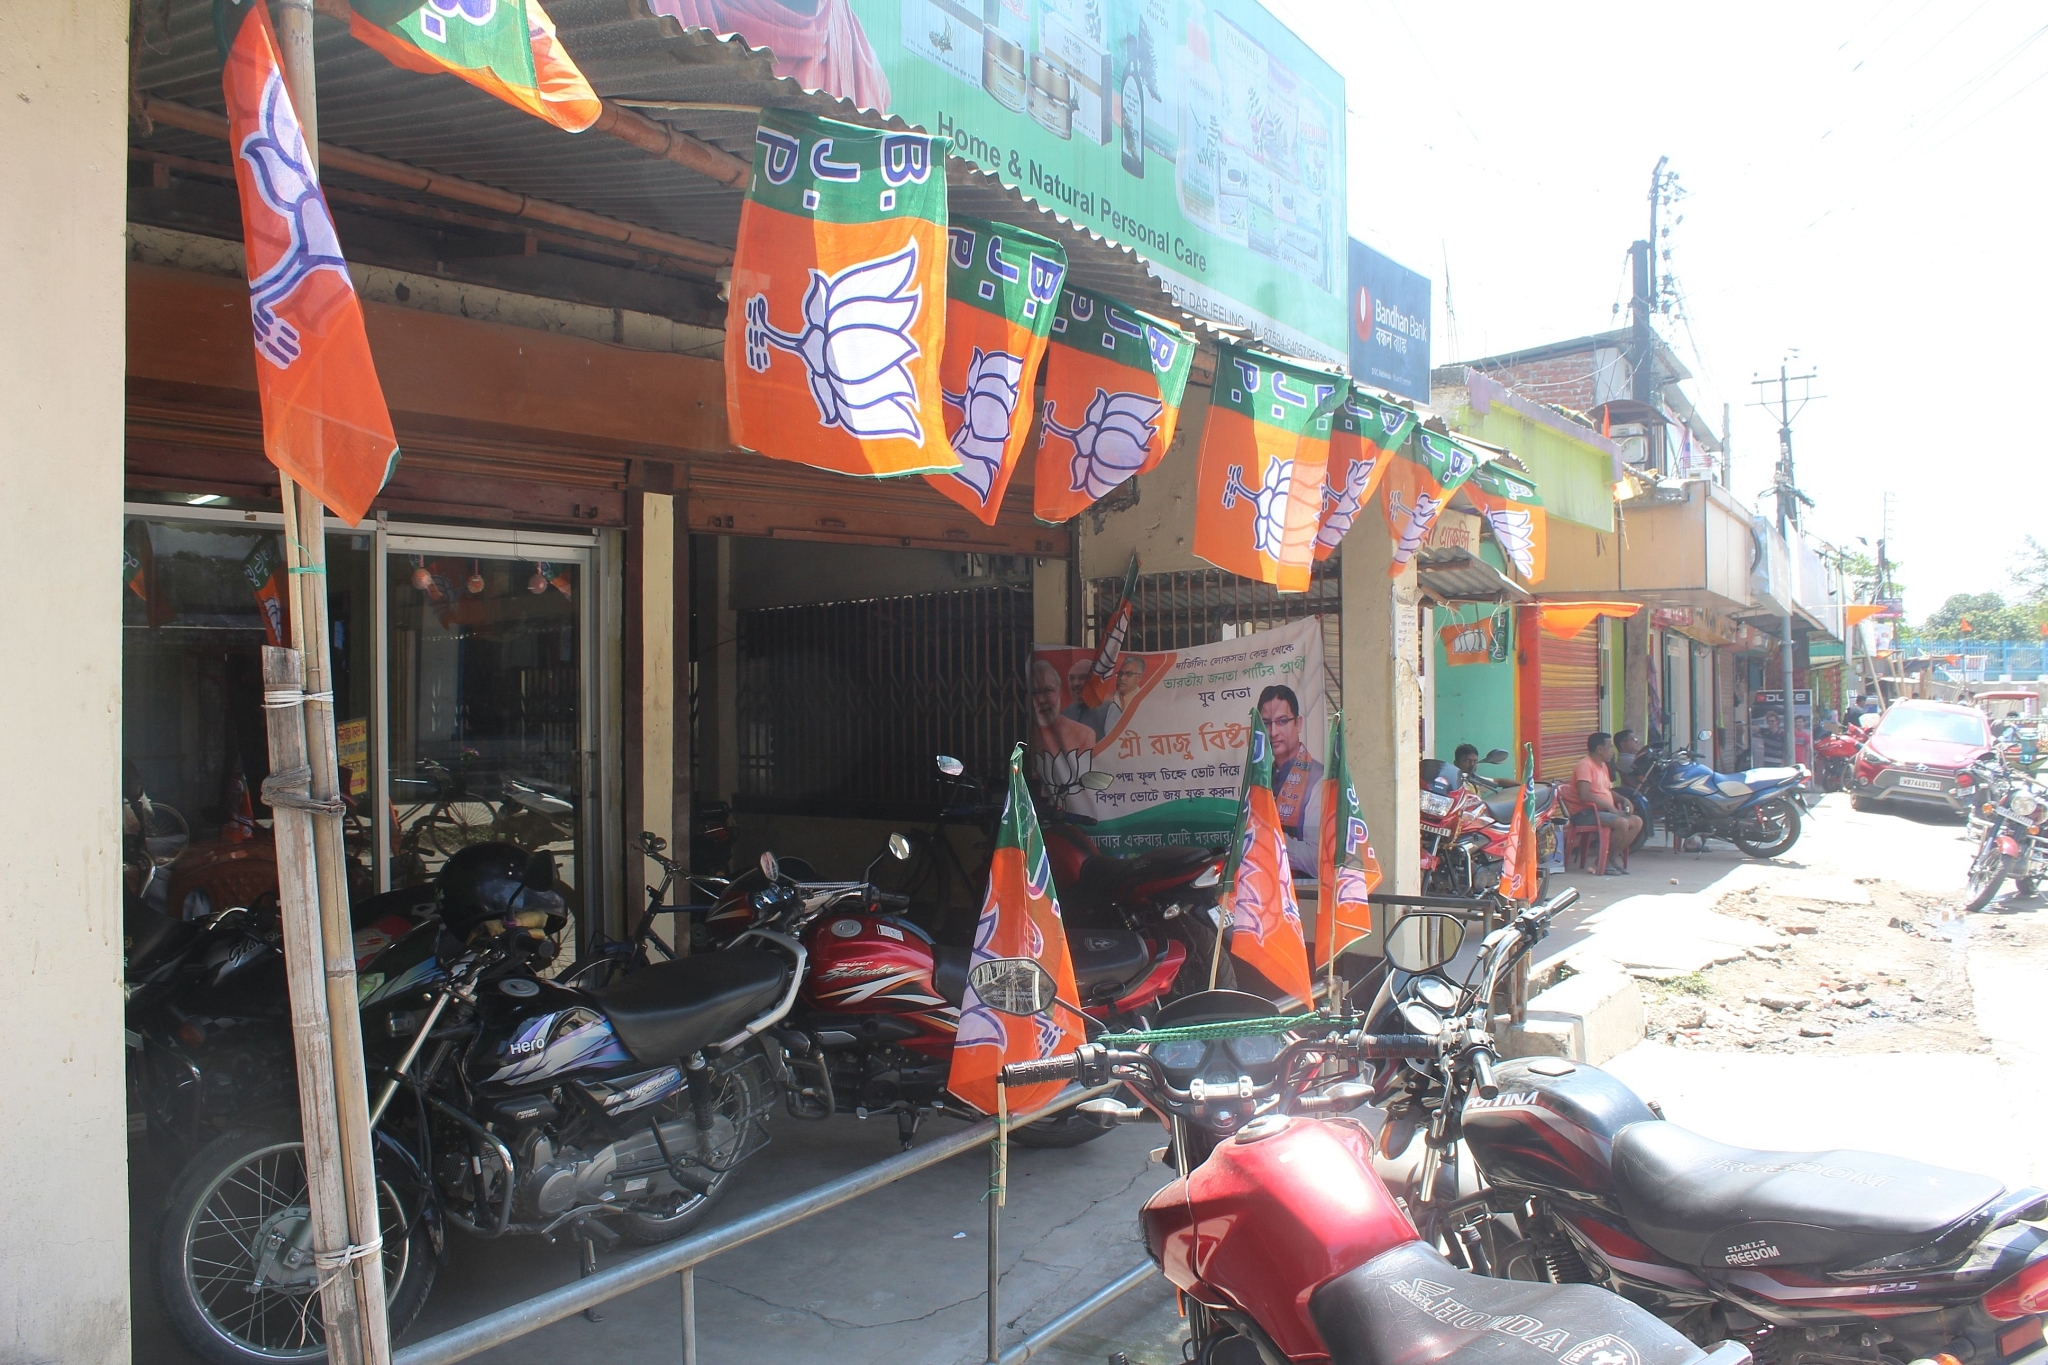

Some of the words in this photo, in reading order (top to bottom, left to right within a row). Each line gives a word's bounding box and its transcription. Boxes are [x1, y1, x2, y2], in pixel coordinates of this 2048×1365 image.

[938, 111, 1001, 168] Home
[1008, 149, 1023, 180] &
[1029, 158, 1095, 217] Natural
[1100, 198, 1170, 255] Personal
[1174, 238, 1207, 273] Care
[1190, 291, 1244, 327] DARJEELING
[1376, 298, 1409, 335] Bandhan
[1410, 315, 1427, 343] Bank
[1210, 652, 1247, 666] লোকসভা
[1271, 643, 1295, 655] থেকে
[1163, 673, 1204, 689] ভারতীয়
[1208, 670, 1238, 684] জনতা
[1242, 662, 1276, 679] পার্টির
[1198, 691, 1216, 708] যুব
[1221, 686, 1252, 701] নেতা
[1118, 729, 1141, 760] শ্রী
[1148, 733, 1195, 761] রাজু
[1116, 771, 1135, 783] পদ্ম
[1137, 771, 1157, 786] ফুল
[1161, 767, 1187, 781] চিহ্নে
[1192, 765, 1216, 779] ভোট
[1219, 762, 1241, 777] দিয়ে
[1095, 790, 1126, 807] বিপুল
[1130, 788, 1159, 803] ভোটে
[1162, 789, 1182, 801] জয়
[1185, 788, 1205, 803] যুক্ত
[1168, 828, 1191, 846] মোদি
[510, 1036, 545, 1055] Hero
[1725, 1245, 1781, 1265] FREEDOM
[1733, 1241, 1760, 1252] LML
[1867, 1280, 1919, 1294] 125
[1429, 1296, 1571, 1353] HONDA
